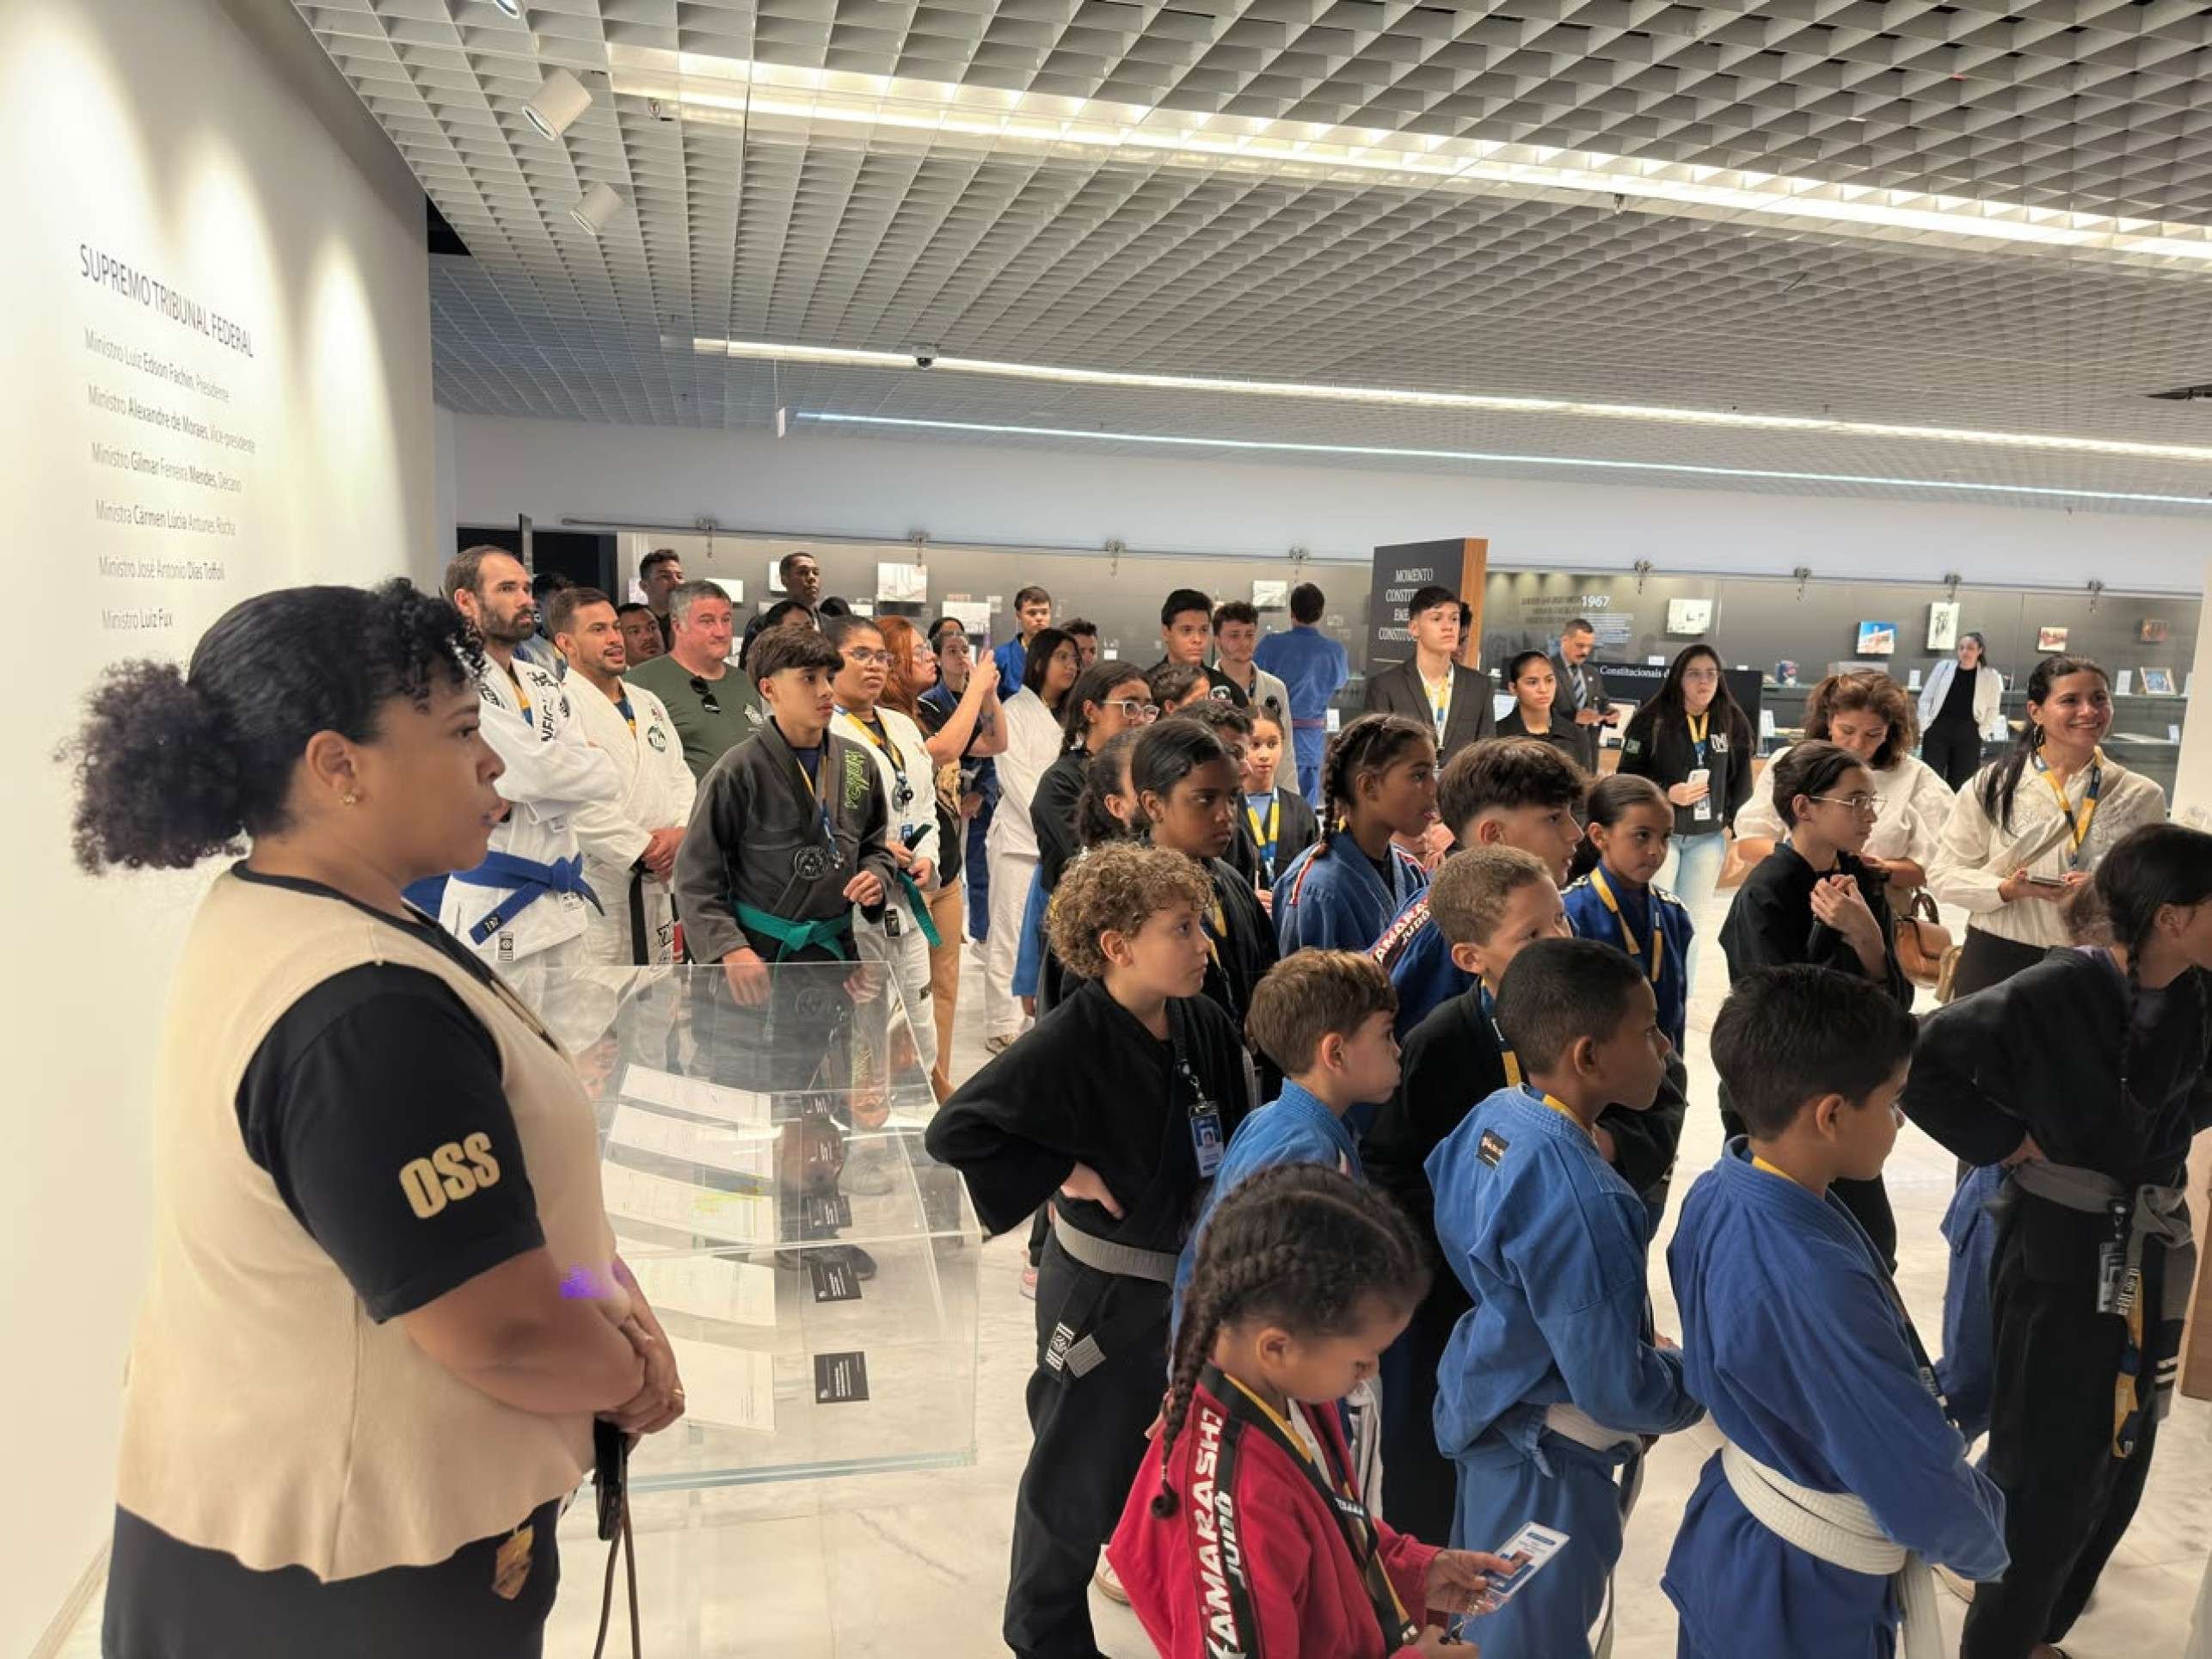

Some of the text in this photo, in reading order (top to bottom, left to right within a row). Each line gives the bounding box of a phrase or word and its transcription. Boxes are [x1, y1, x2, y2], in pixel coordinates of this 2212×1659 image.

[79, 243, 254, 358] SUPREMO TRIBUNAL FEDERAL
[85, 327, 123, 362] Ministro
[144, 352, 168, 378] Edson
[88, 384, 126, 415] Ministro
[129, 396, 170, 428] Alexandre
[171, 410, 181, 432] de
[92, 442, 130, 470] Ministro
[132, 451, 159, 475] Gilmar
[96, 499, 132, 524] Ministra
[99, 556, 136, 578] Ministro
[1395, 568, 1434, 583] MOMENTO
[1582, 594, 1610, 608] 1967
[101, 607, 174, 630] Ministro Luiz Fux
[398, 1131, 501, 1220] OSS
[1214, 1490, 1247, 1589] JUDO
